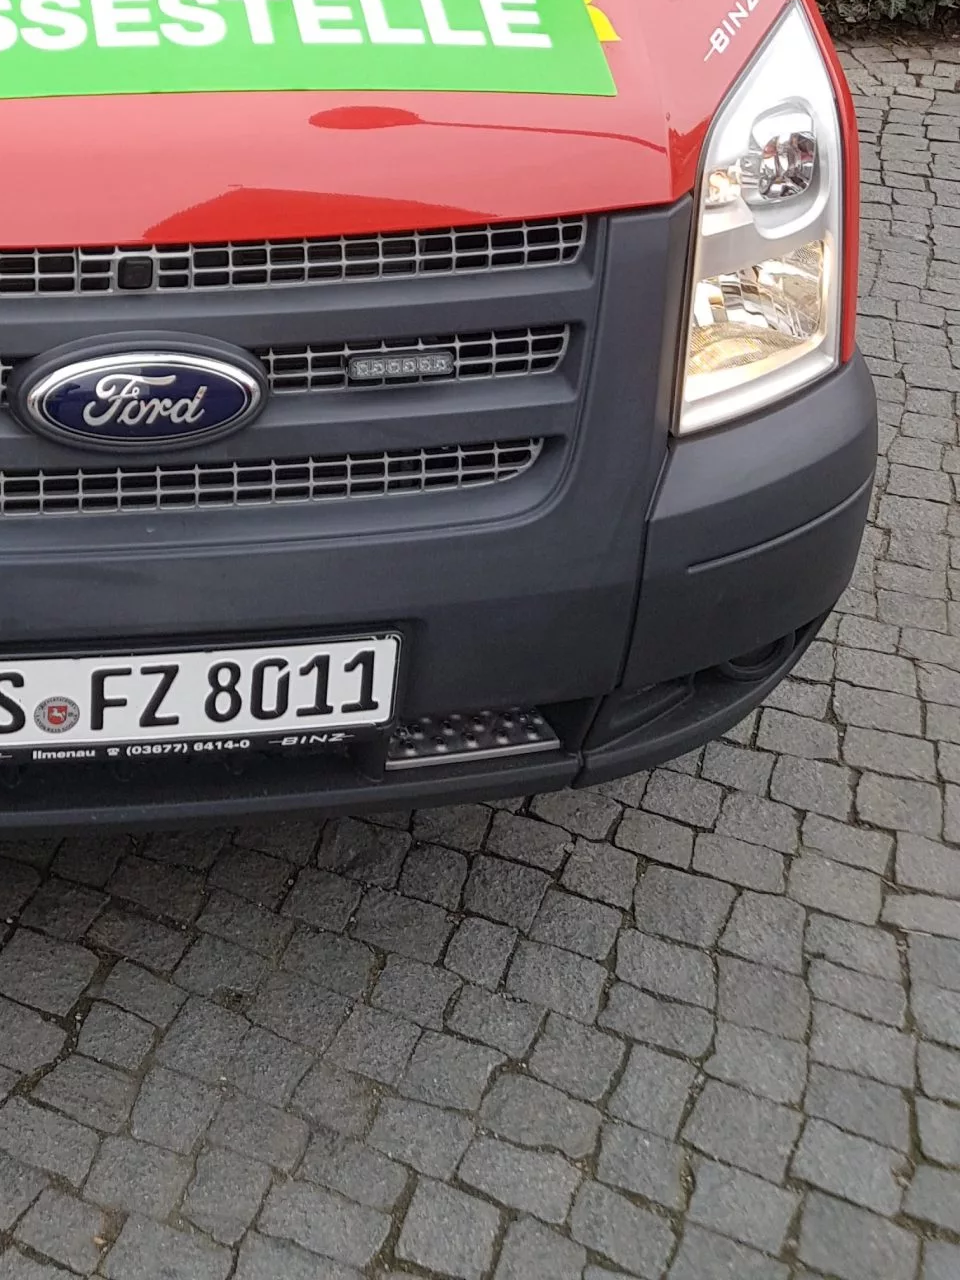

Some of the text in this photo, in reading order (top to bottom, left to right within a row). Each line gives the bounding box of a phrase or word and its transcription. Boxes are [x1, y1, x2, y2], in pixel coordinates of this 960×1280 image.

[83, 373, 207, 426] Ford
[90, 664, 180, 730] FZ
[205, 650, 379, 723] 8011
[32, 749, 95, 760] Ilmenau
[126, 743, 188, 756] (03677)
[194, 739, 250, 751] 6414-0
[281, 733, 345, 746] BINZ
